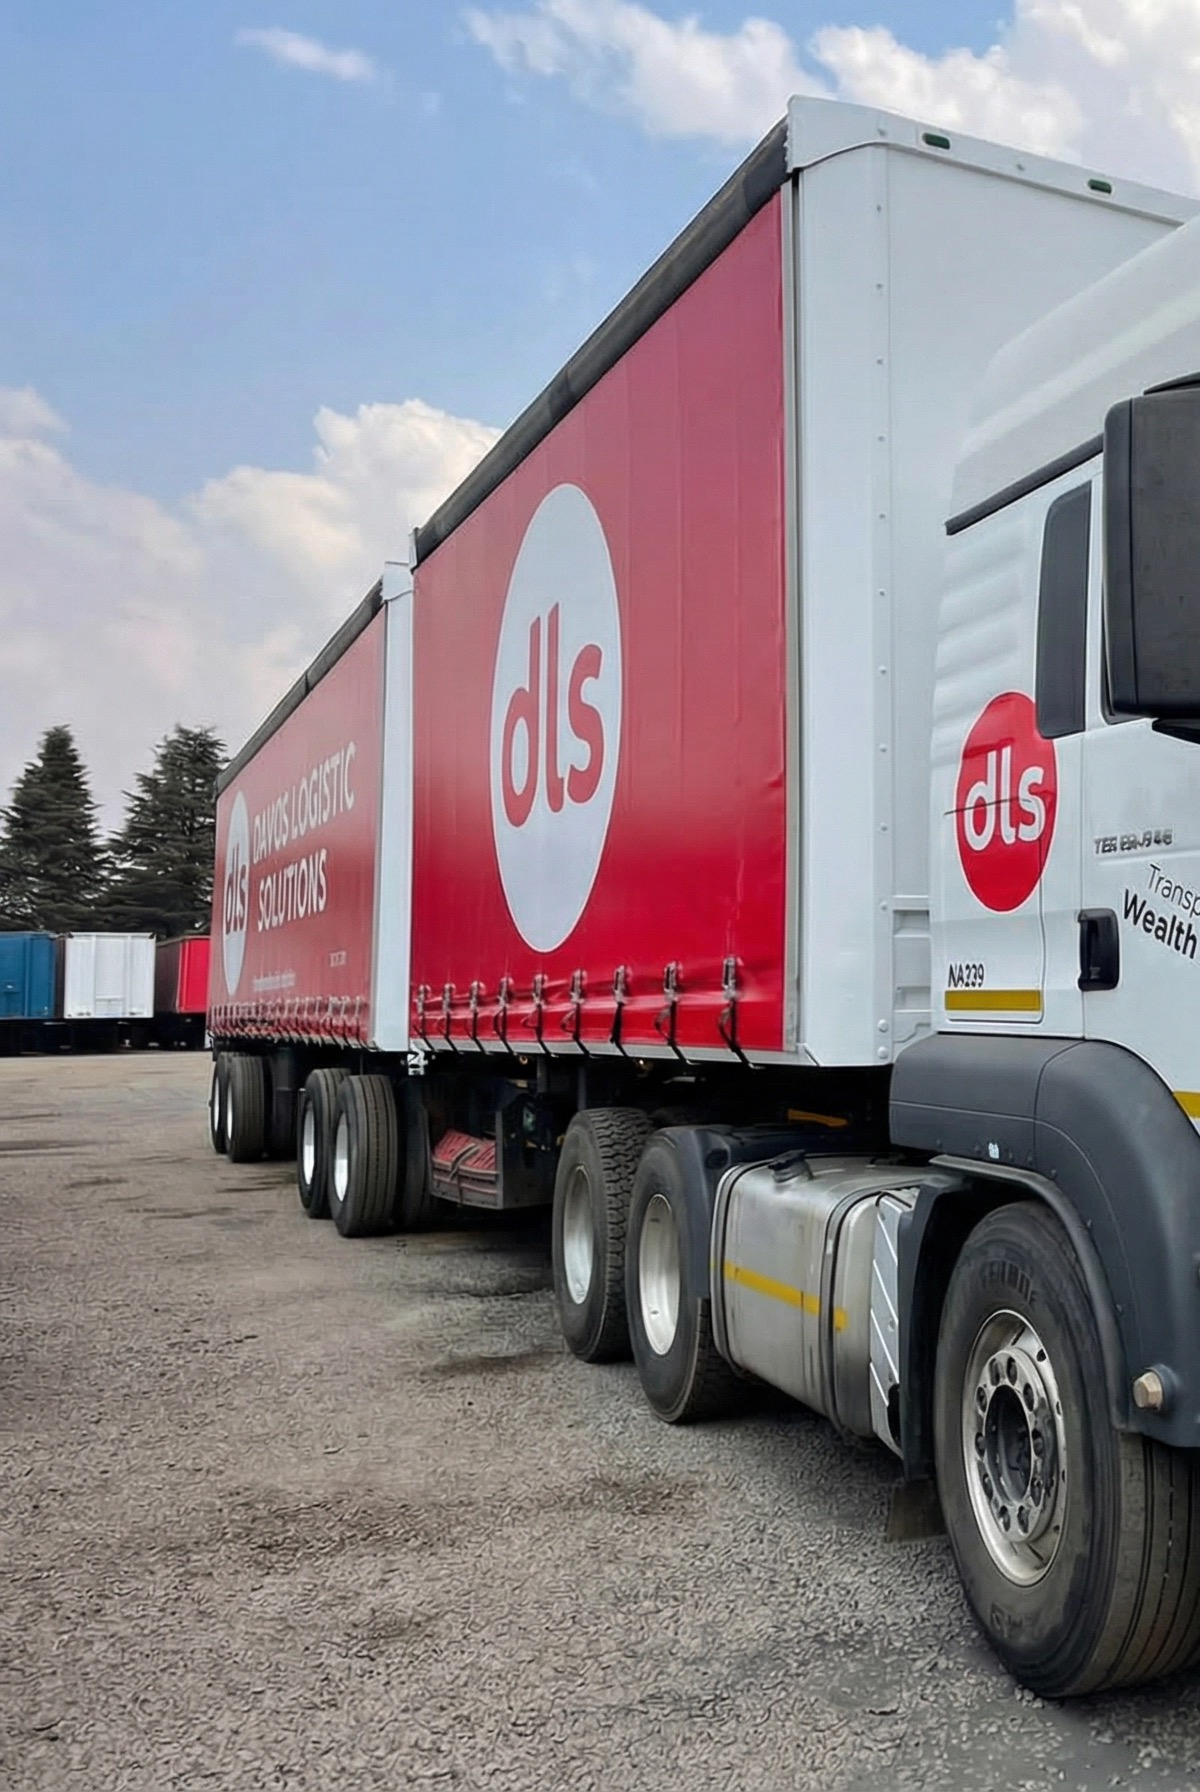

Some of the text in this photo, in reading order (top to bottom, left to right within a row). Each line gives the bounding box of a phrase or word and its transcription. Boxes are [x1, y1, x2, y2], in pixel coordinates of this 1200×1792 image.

[502, 601, 604, 828] dls
[253, 741, 356, 864] DAVOS LOGISTIC
[963, 745, 1046, 853] dls
[257, 849, 327, 932] SOLUTIONS
[1122, 890, 1198, 959] Wealth
